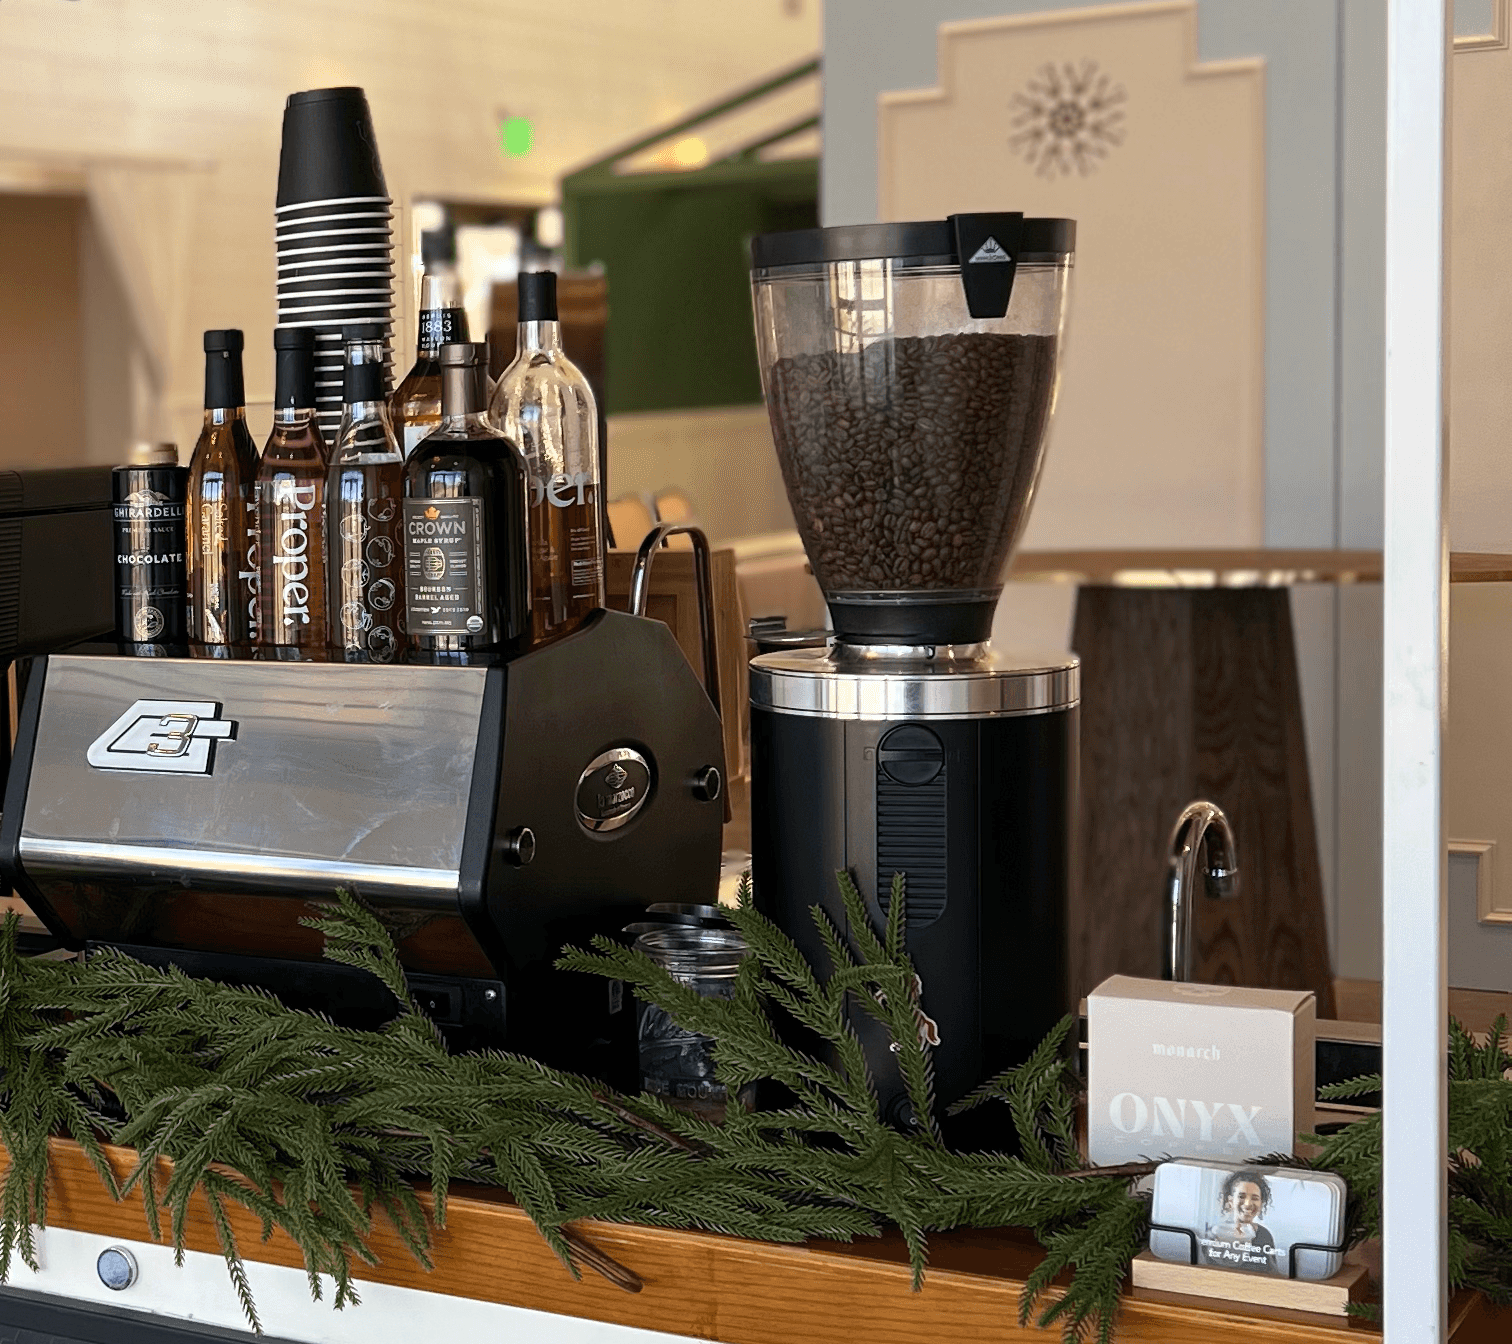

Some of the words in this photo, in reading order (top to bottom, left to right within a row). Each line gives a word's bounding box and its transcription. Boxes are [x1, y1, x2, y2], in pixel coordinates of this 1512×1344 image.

[421, 319, 452, 334] 1883
[114, 506, 184, 519] GHIRARDELLI
[201, 503, 214, 555] Caramel
[408, 520, 466, 536] CROWN
[117, 552, 183, 565] CHOCOLATE
[273, 484, 316, 626] Proper.
[1151, 1043, 1221, 1061] monarch
[1109, 1092, 1263, 1146] ONYX
[1208, 1248, 1222, 1258] for
[1223, 1249, 1241, 1263] Any
[1242, 1252, 1267, 1265] Event
[1232, 1241, 1262, 1253] Coffee
[1263, 1244, 1286, 1256] Carts
